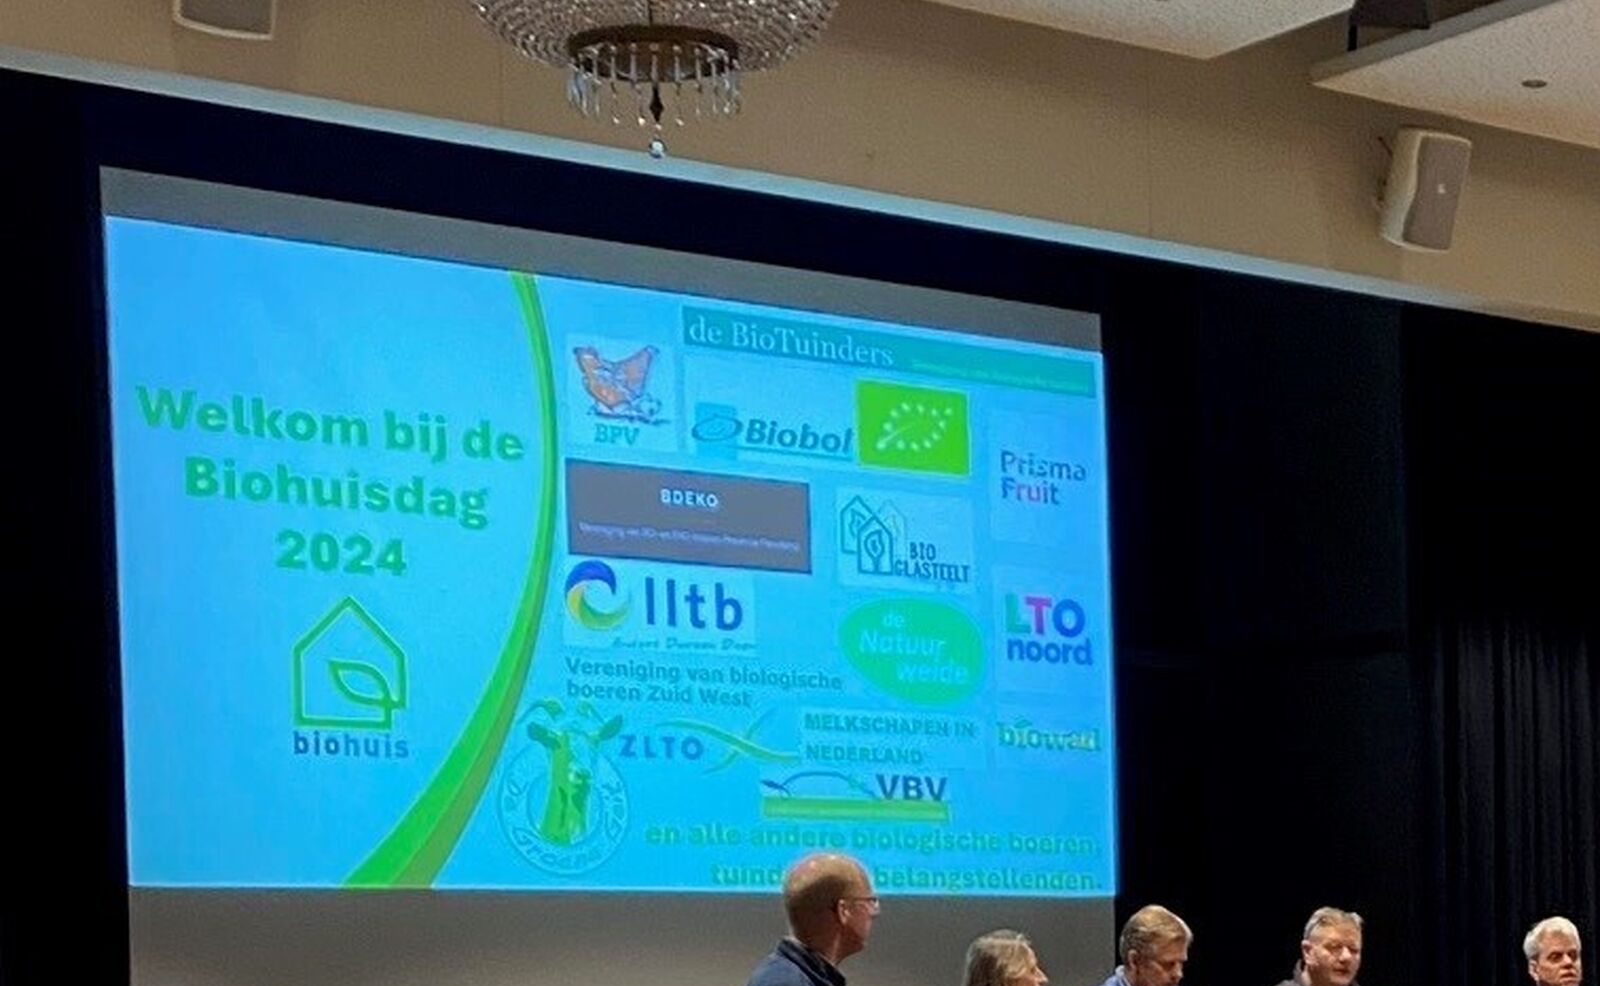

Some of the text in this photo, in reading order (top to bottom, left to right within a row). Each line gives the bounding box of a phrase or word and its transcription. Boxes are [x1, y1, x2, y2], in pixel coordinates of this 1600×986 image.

[689, 315, 894, 366] de BioTuinders
[136, 386, 525, 464] Welkom bij de
[745, 418, 854, 452] Biobol
[1001, 450, 1087, 481] Prisma
[184, 456, 489, 530] Biohuisdag
[1001, 476, 1060, 505] Fruit
[276, 530, 407, 576] 2024
[909, 542, 936, 561] BIO
[645, 577, 743, 631] lltb
[1004, 593, 1086, 638] LTO
[883, 611, 905, 628] de
[1006, 637, 1094, 666] noord
[565, 657, 842, 690] Vereniging van biologische
[567, 680, 751, 707] boeren Zuid West
[804, 713, 977, 738] MELKSCHAPEN IN
[293, 731, 409, 758] biohuis
[619, 735, 705, 760] ZLTO
[805, 744, 923, 765] NEDERLAND
[875, 774, 948, 801] VBV
[645, 825, 680, 844] en
[687, 821, 741, 845] alle
[750, 827, 846, 848] andere
[852, 827, 999, 853] biologische
